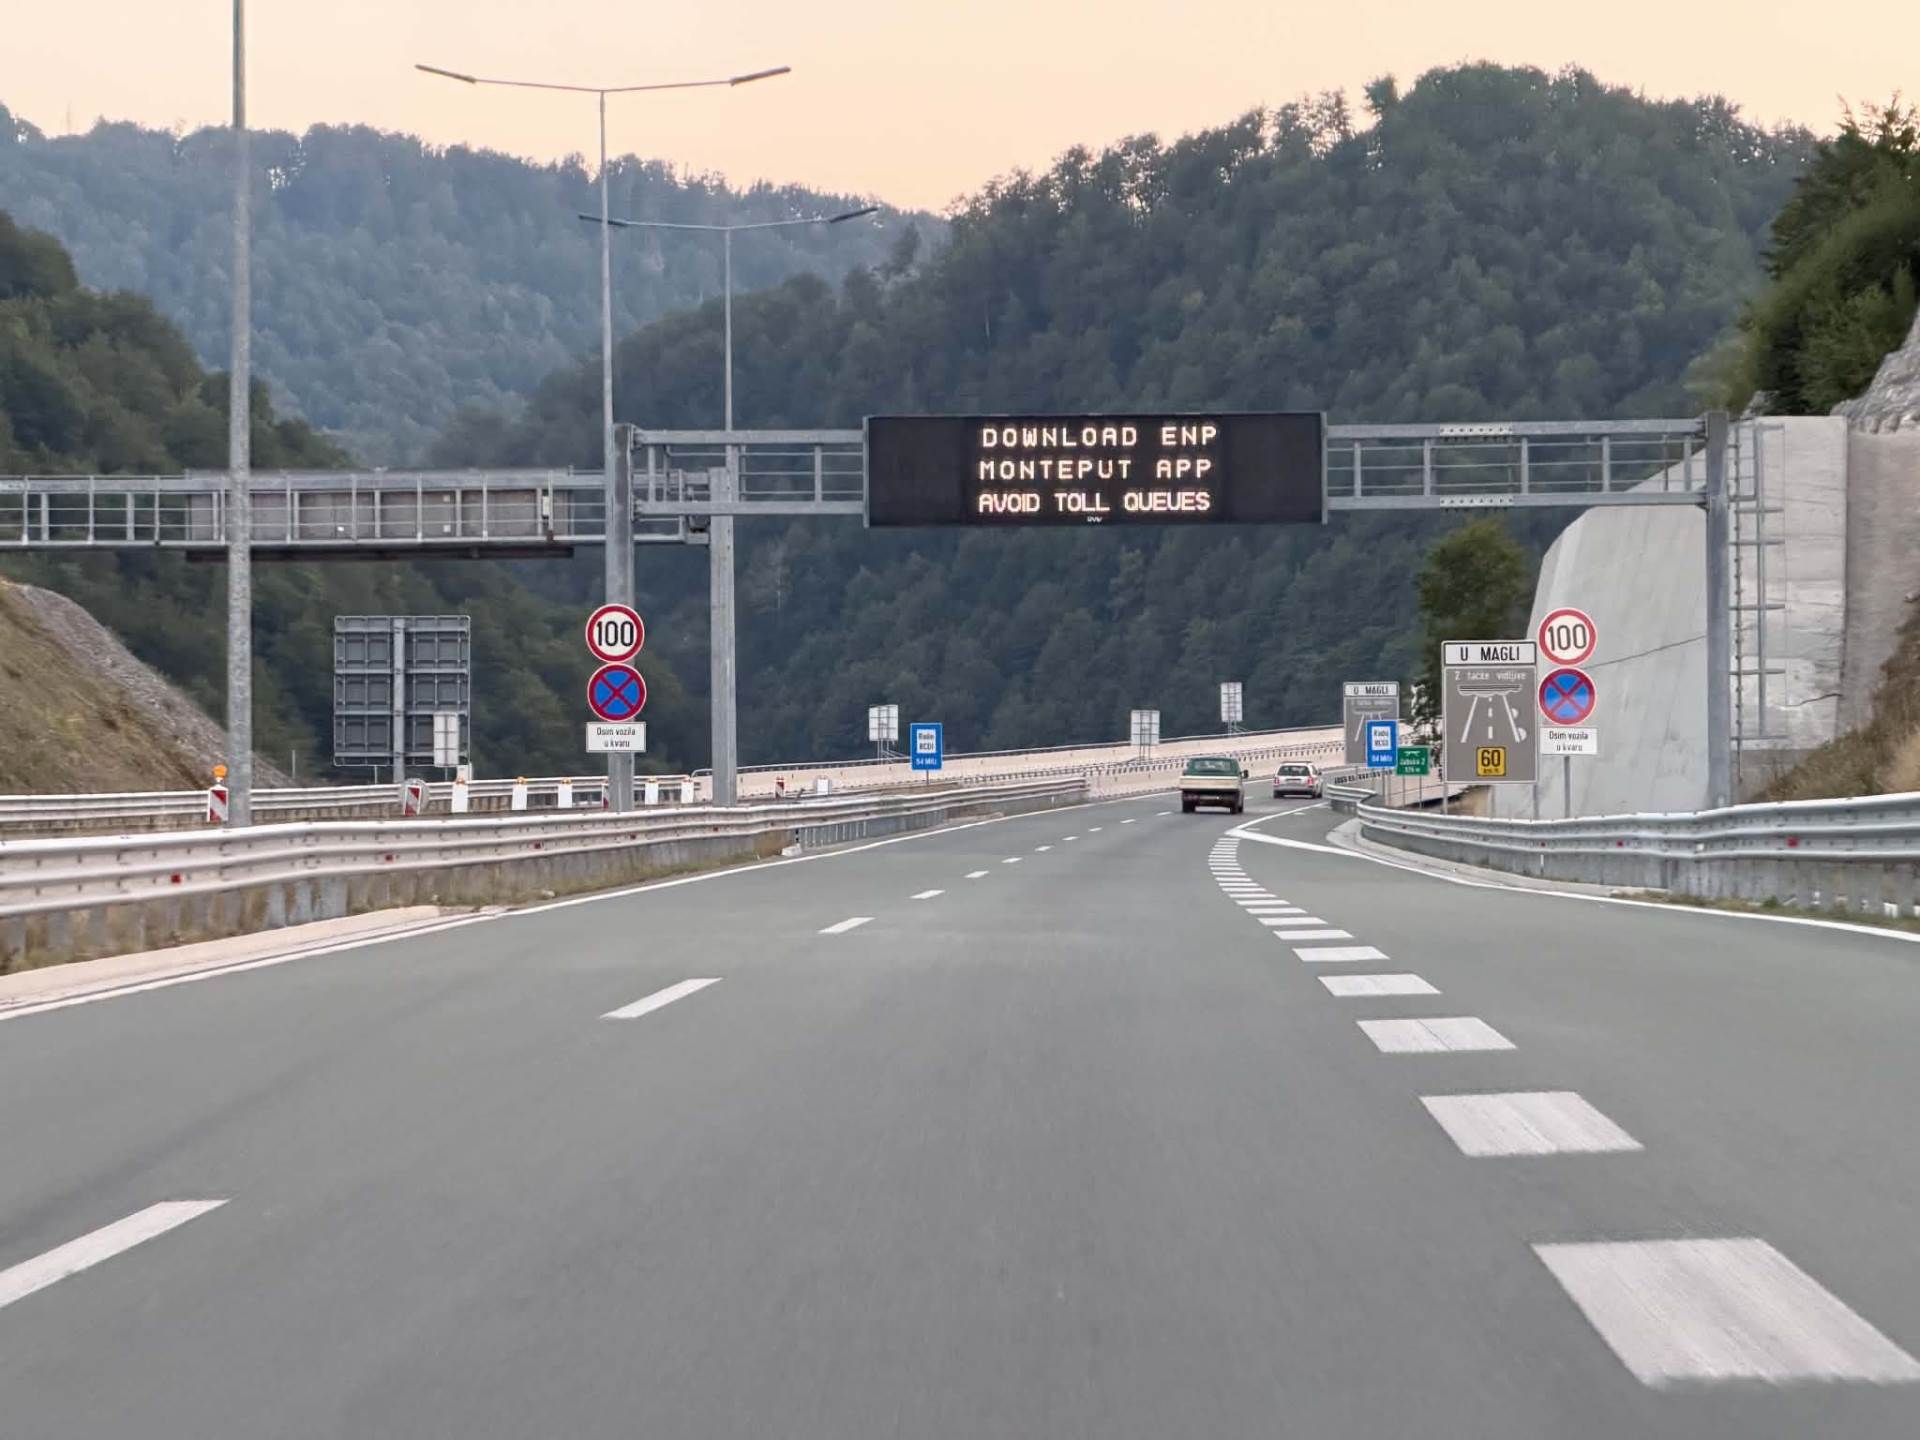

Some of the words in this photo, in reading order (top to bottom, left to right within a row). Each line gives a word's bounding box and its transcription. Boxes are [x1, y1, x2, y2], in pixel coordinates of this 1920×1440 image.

[982, 427, 1137, 447] DOWNLOAD
[1161, 426, 1217, 446] ENP
[979, 460, 1132, 480] MONTEPUT
[1156, 459, 1212, 479] APP
[979, 493, 1041, 513] AVOID
[1054, 492, 1110, 512] TOLL
[1124, 492, 1211, 511] QUEUES
[597, 621, 634, 646] 100
[1548, 624, 1587, 651] 100
[1460, 647, 1468, 661] U
[1480, 646, 1520, 661] MAGLI
[1353, 687, 1359, 695] U
[1365, 686, 1389, 695] MAGLI
[1481, 749, 1501, 766] 60
